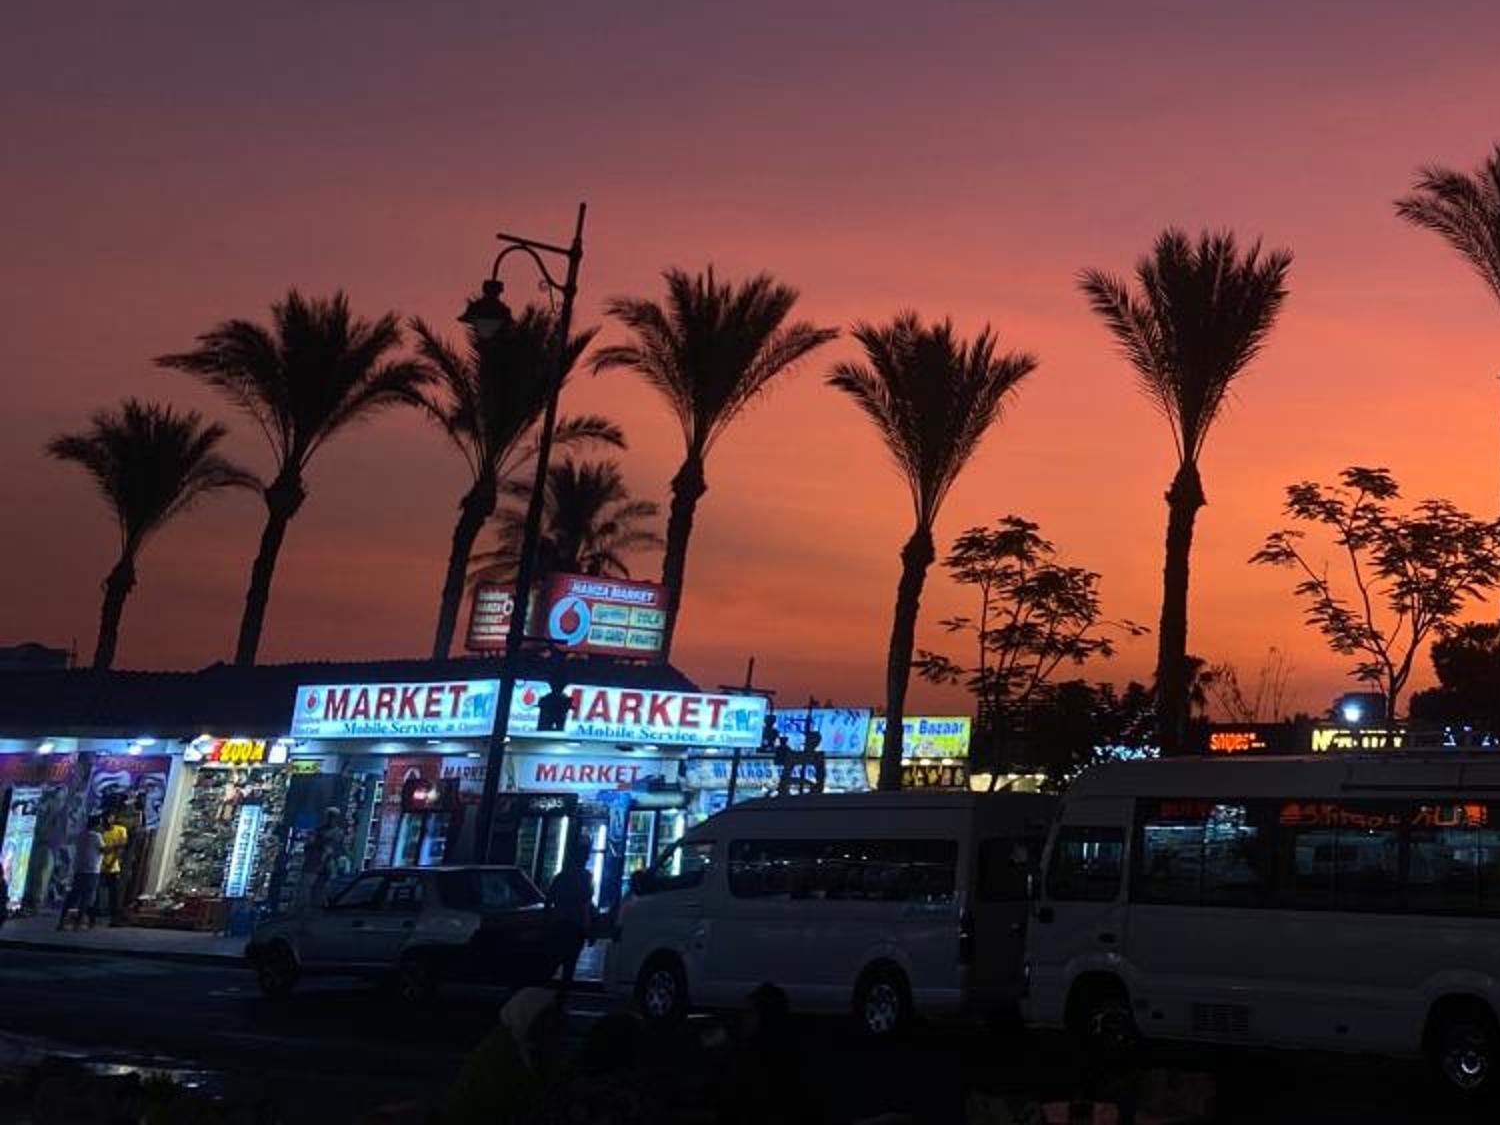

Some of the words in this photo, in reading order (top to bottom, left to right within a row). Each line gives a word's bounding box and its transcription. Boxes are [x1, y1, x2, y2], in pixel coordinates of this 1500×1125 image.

[324, 685, 469, 720] MARKET
[344, 721, 385, 735] Mobile
[391, 720, 439, 735] Service
[577, 722, 635, 740] Mobile
[639, 725, 698, 743] Service
[919, 719, 965, 735] Bazaar
[443, 763, 489, 781] MARKE
[535, 762, 641, 783] MARKET
